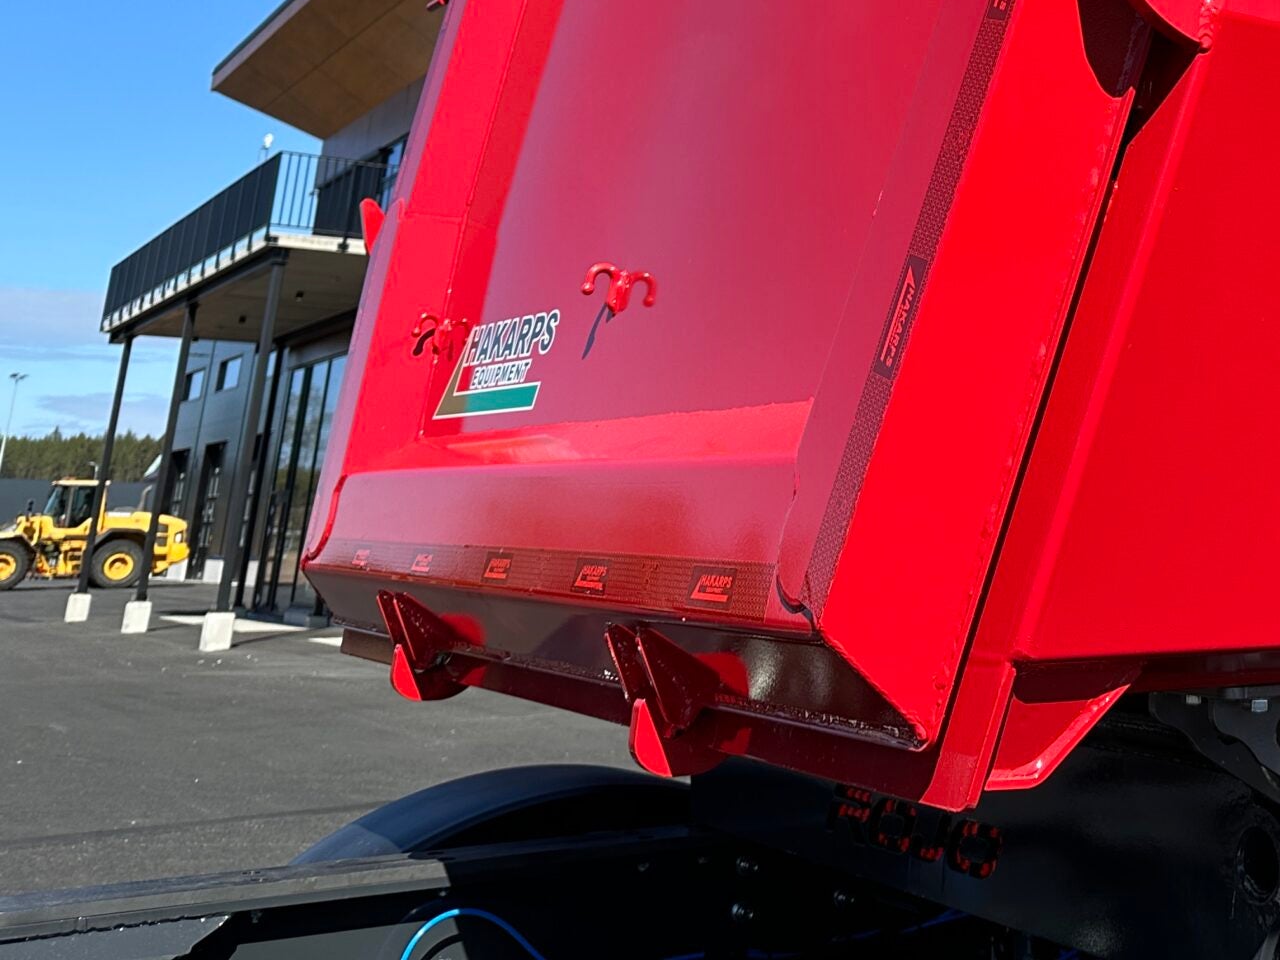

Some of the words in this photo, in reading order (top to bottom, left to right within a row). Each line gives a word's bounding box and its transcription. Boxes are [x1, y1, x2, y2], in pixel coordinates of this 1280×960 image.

[462, 309, 561, 366] HAKARPS
[469, 359, 533, 389] EQUIPMENT
[700, 574, 733, 589] HAKARPS
